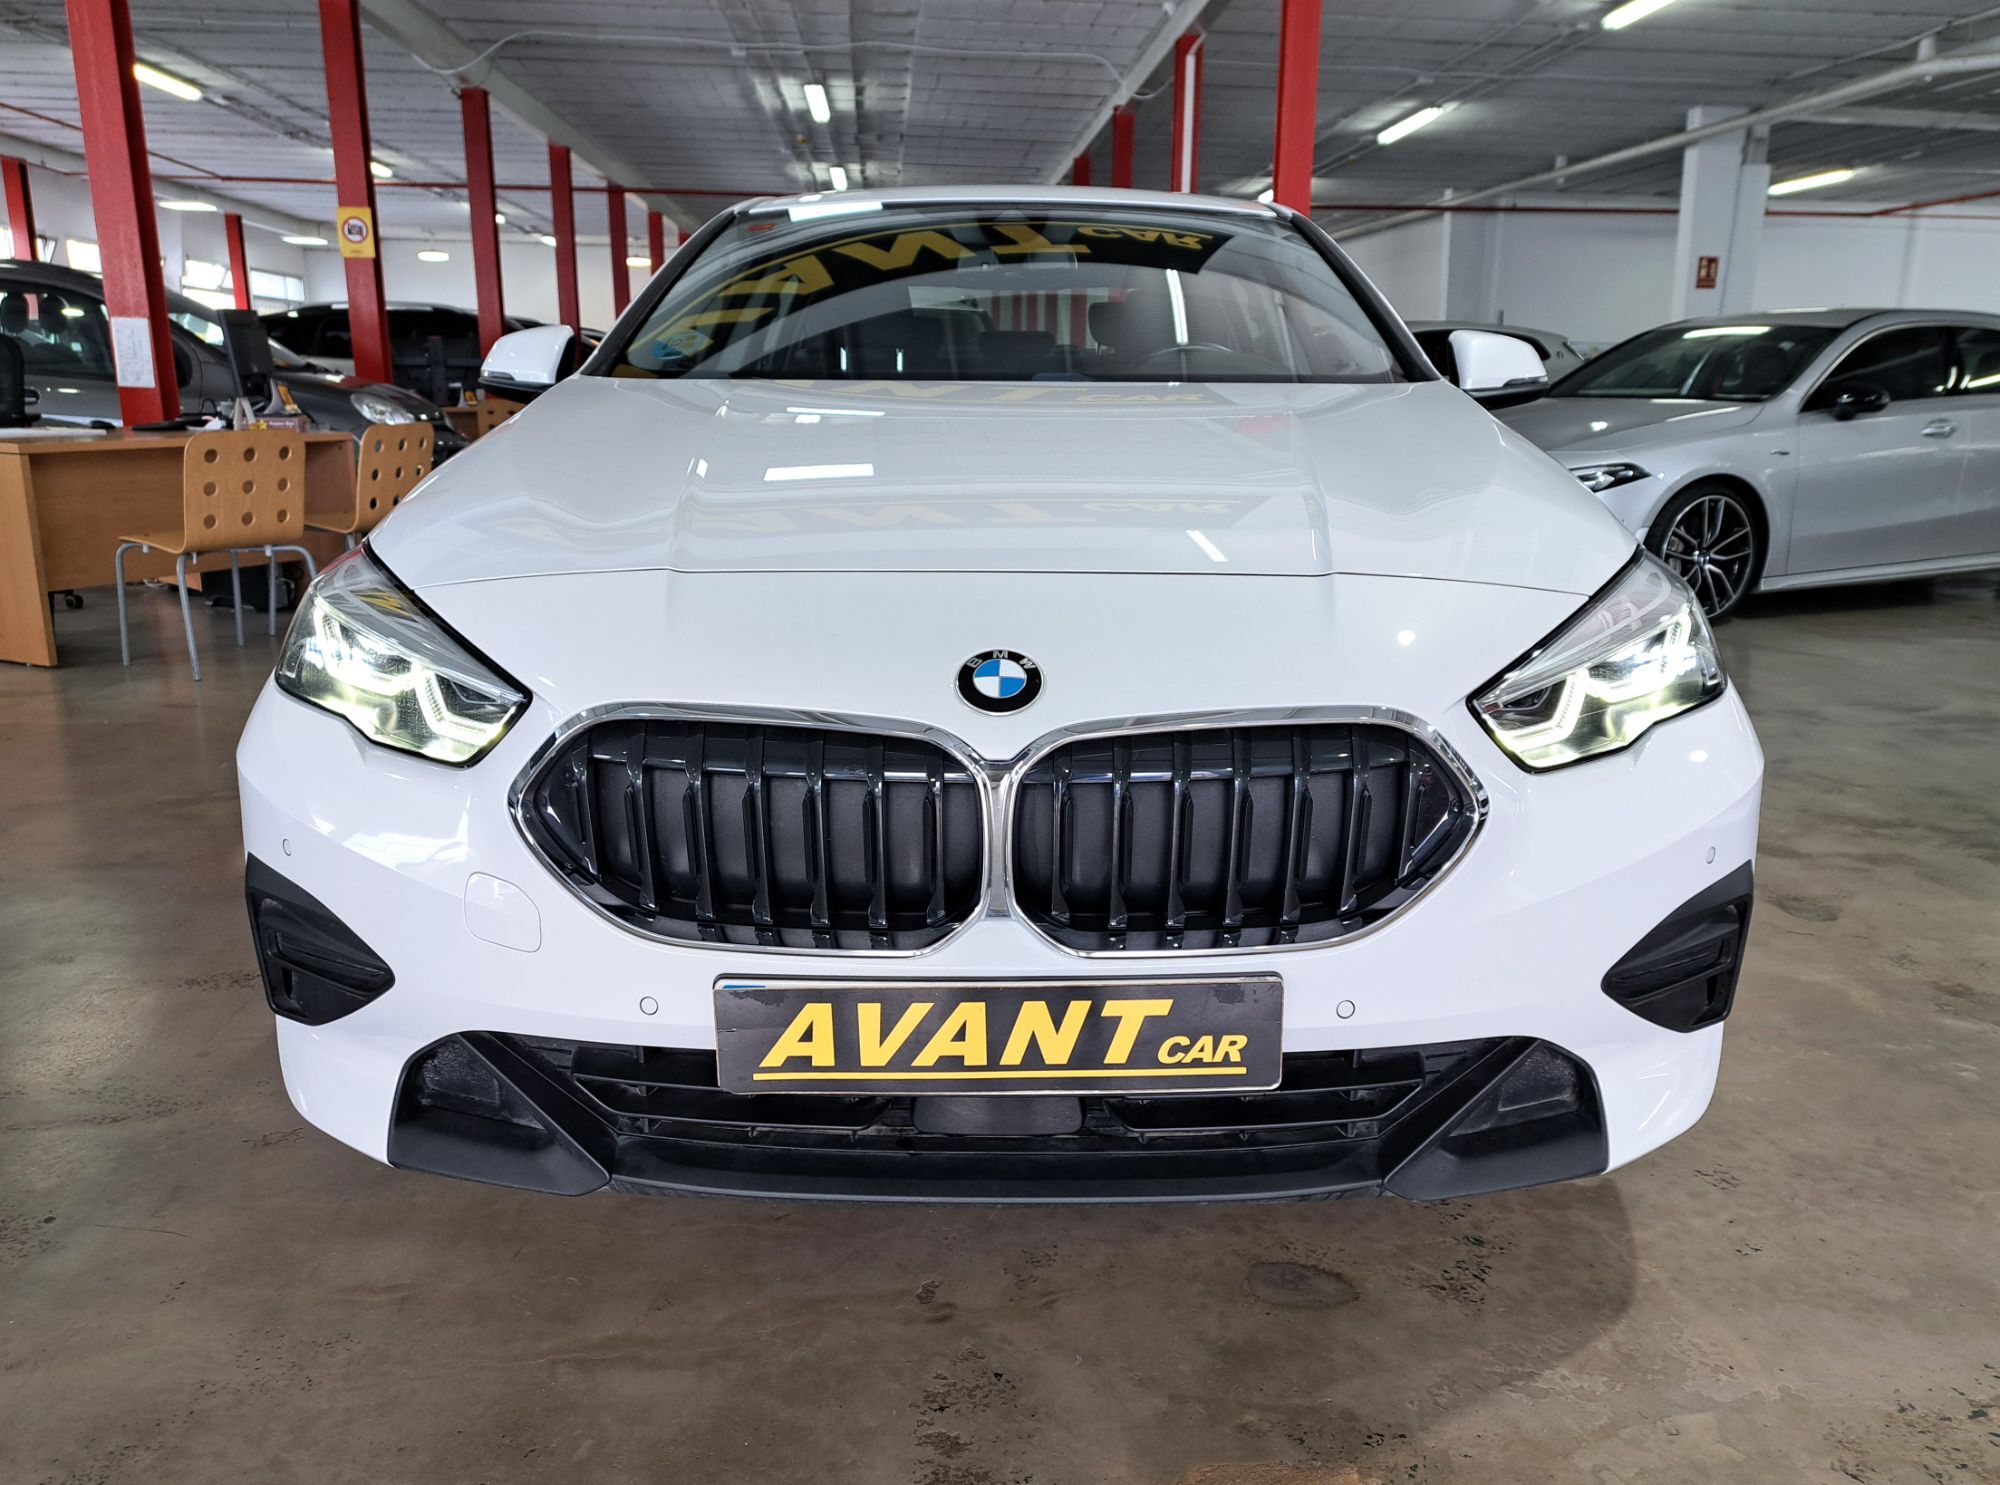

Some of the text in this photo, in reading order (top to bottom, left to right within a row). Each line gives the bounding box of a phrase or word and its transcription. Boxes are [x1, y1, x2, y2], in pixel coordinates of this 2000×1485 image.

[966, 650, 1036, 669] BMW
[759, 998, 1249, 1067] AVANT CAR
